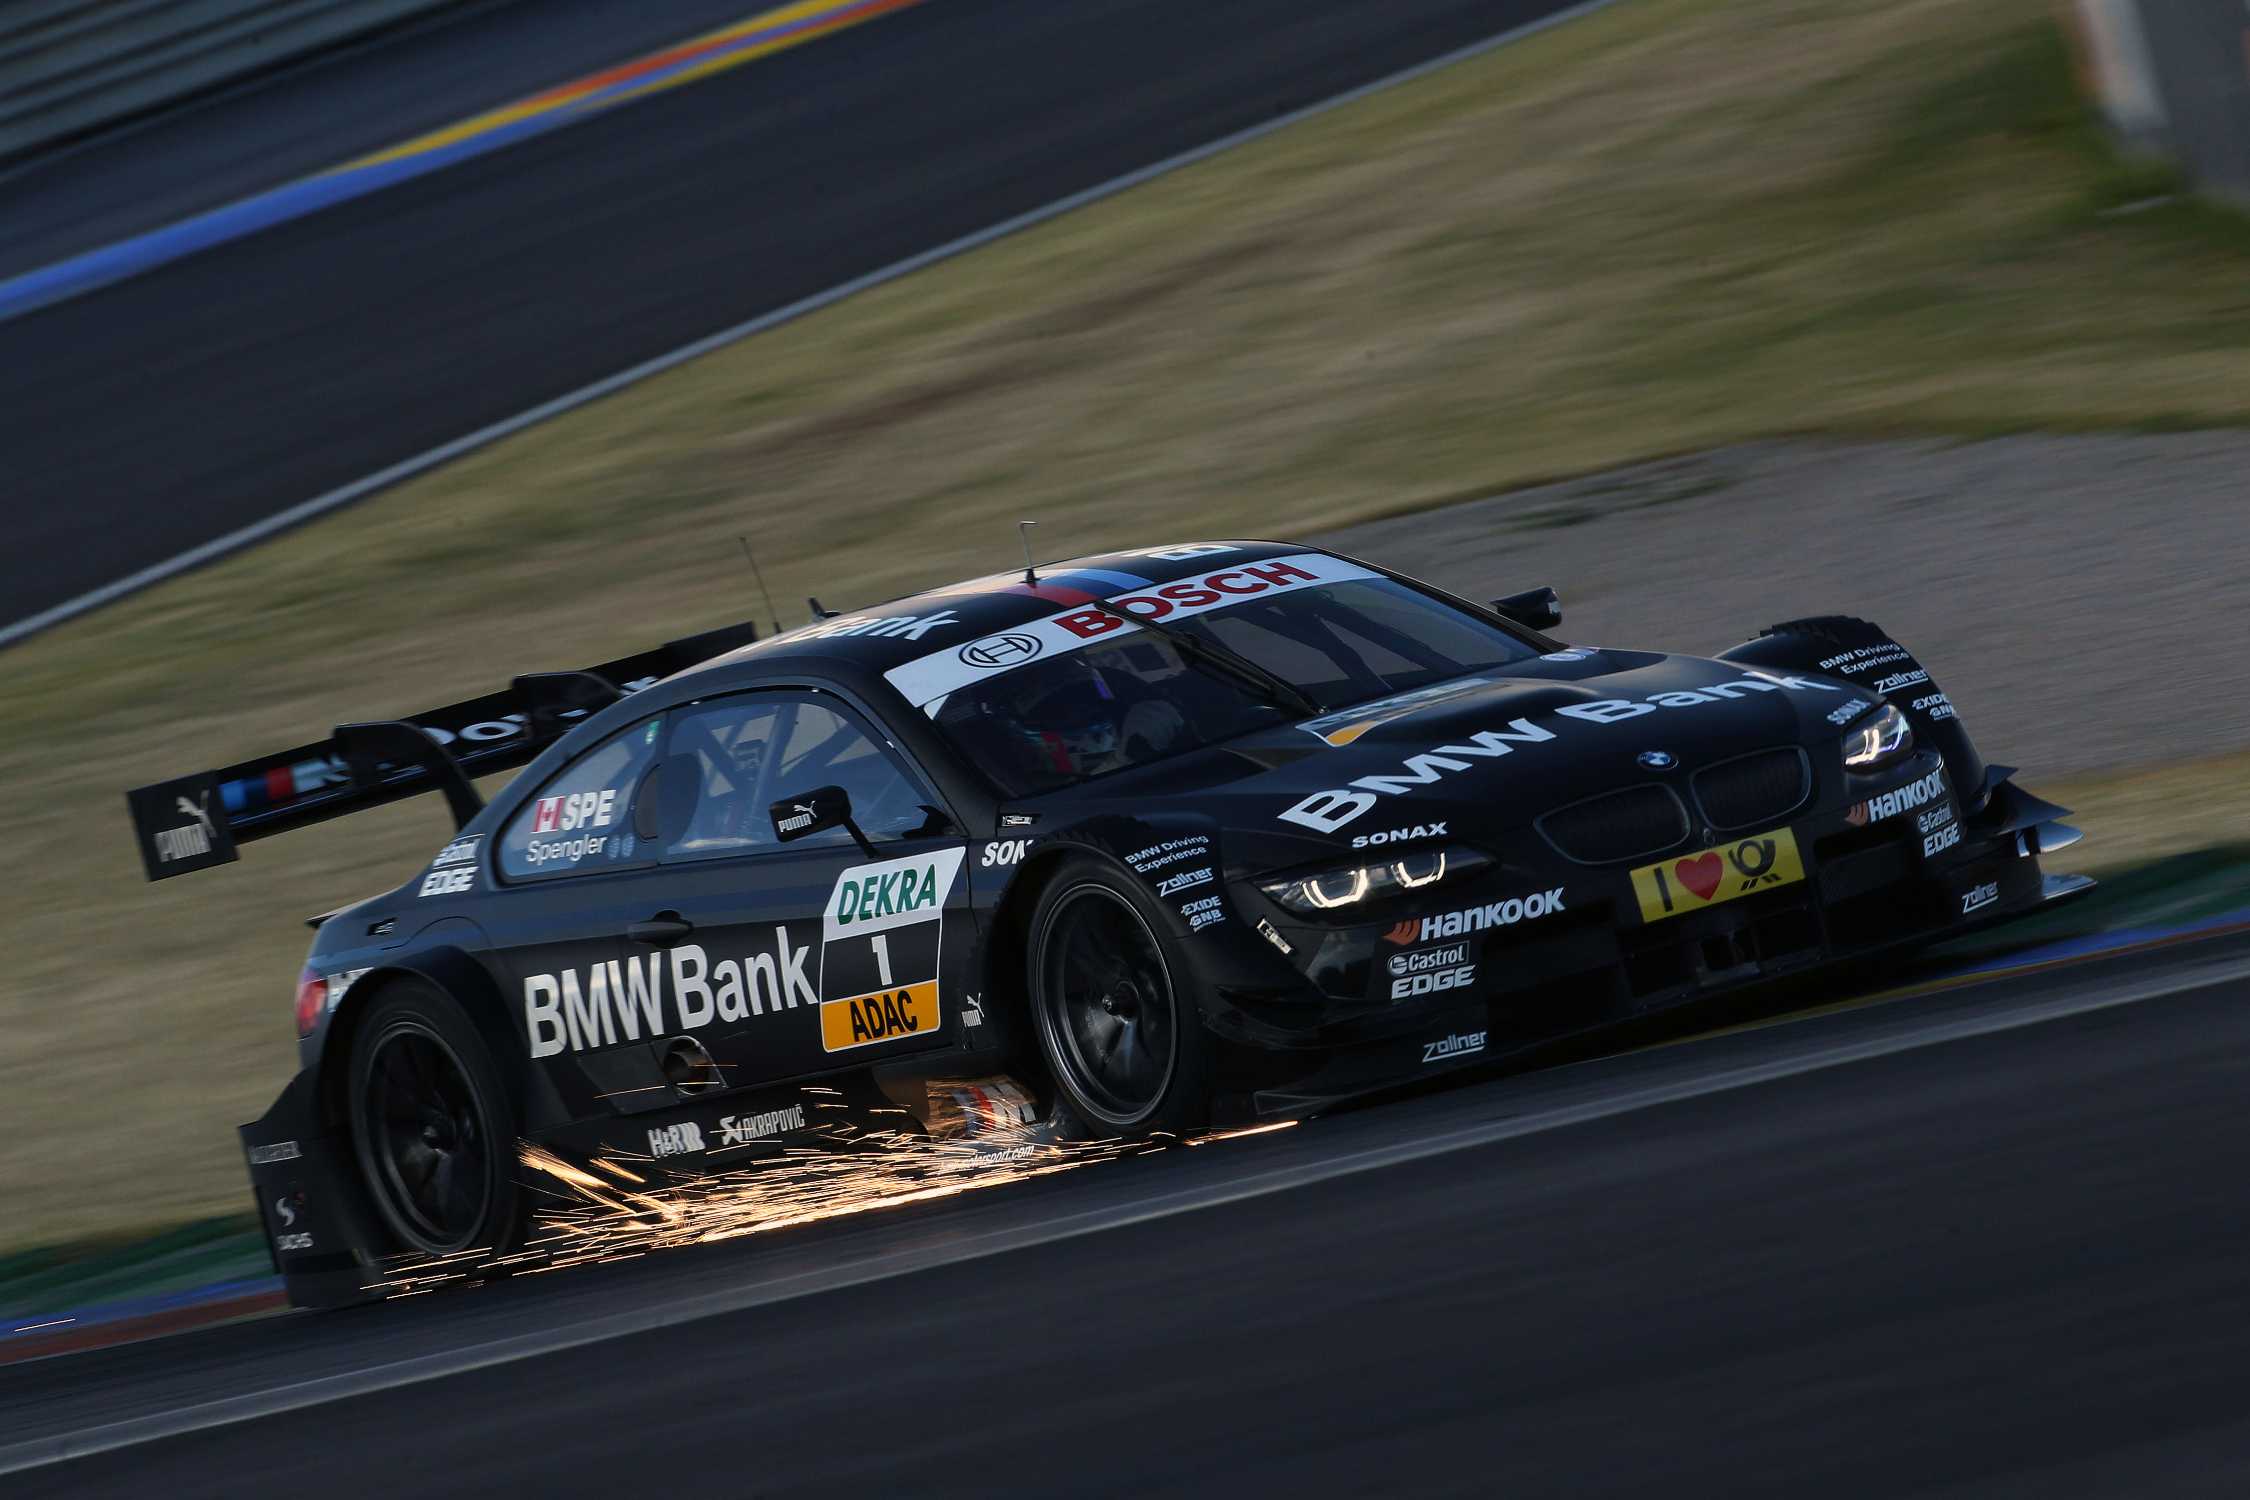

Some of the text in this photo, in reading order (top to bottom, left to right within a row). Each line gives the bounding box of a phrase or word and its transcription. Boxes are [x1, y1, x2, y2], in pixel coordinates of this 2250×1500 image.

[1052, 562, 1320, 639] BOSCH
[1819, 651, 1854, 669] BMW
[1840, 650, 1910, 675] Experience
[1276, 717, 1557, 834] BMW
[1554, 671, 1841, 724] Bank
[561, 789, 616, 832] SPE
[778, 813, 812, 833] PUMA
[1125, 835, 1209, 865] BMW Driving
[1351, 821, 1449, 849] SONAX
[1923, 821, 1960, 858] EDGE
[525, 836, 608, 866] Spengler
[1134, 846, 1207, 873] Experience
[417, 866, 479, 898] EDGE
[837, 863, 937, 926] DEKRA
[1180, 895, 1222, 916] EXIDE
[1190, 909, 1222, 927] GNB
[871, 934, 893, 986] 1
[1408, 944, 1465, 971] Castrol
[525, 926, 818, 1059] BMW Bank
[1391, 964, 1476, 1000] EDGE
[850, 990, 918, 1042] ADAC
